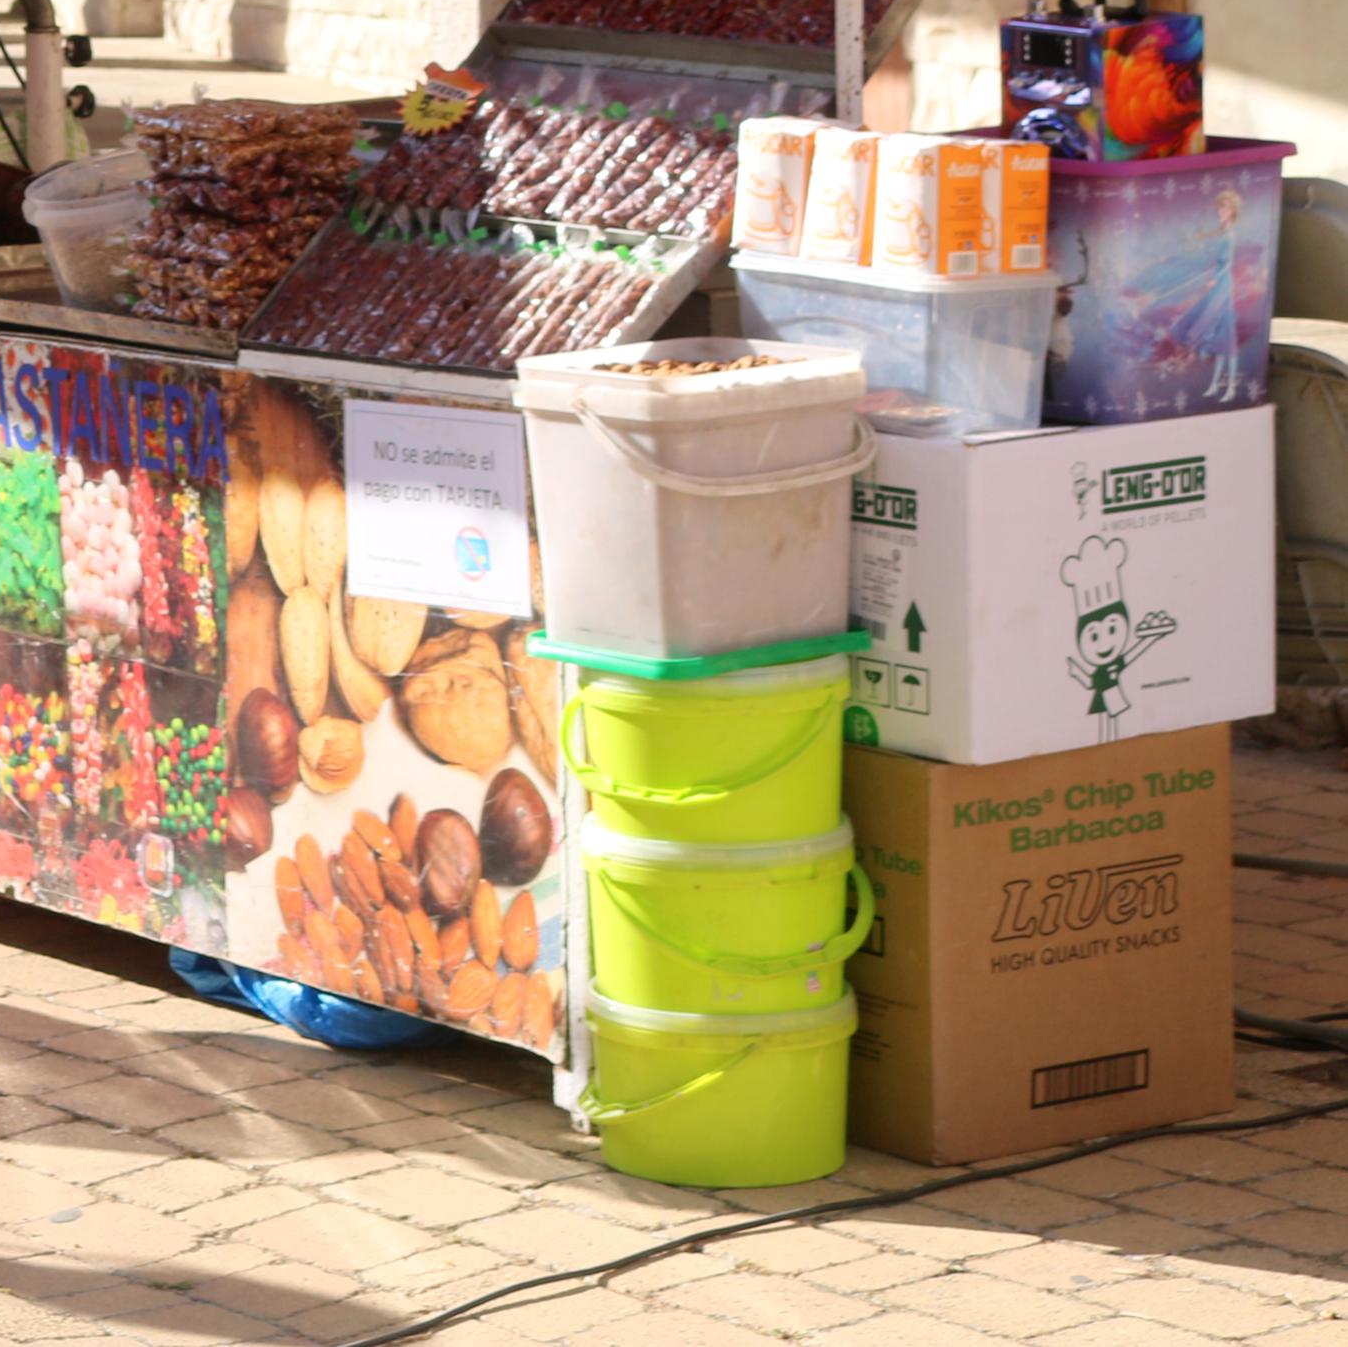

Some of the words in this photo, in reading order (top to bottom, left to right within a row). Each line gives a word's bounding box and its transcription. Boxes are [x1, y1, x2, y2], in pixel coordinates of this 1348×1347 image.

[373, 440, 398, 462] NO
[402, 447, 419, 464] se
[423, 445, 478, 470] admite
[480, 450, 495, 472] el
[363, 480, 400, 504] pago
[404, 485, 432, 503] con
[1063, 779, 1135, 813] Chip
[1142, 766, 1217, 798] Tube
[1009, 808, 1165, 853] Barbacoa
[870, 843, 925, 877] Tube
[990, 952, 1035, 975] HIGH
[1040, 938, 1111, 967] QUALITY
[1115, 925, 1182, 954] SNACKS
